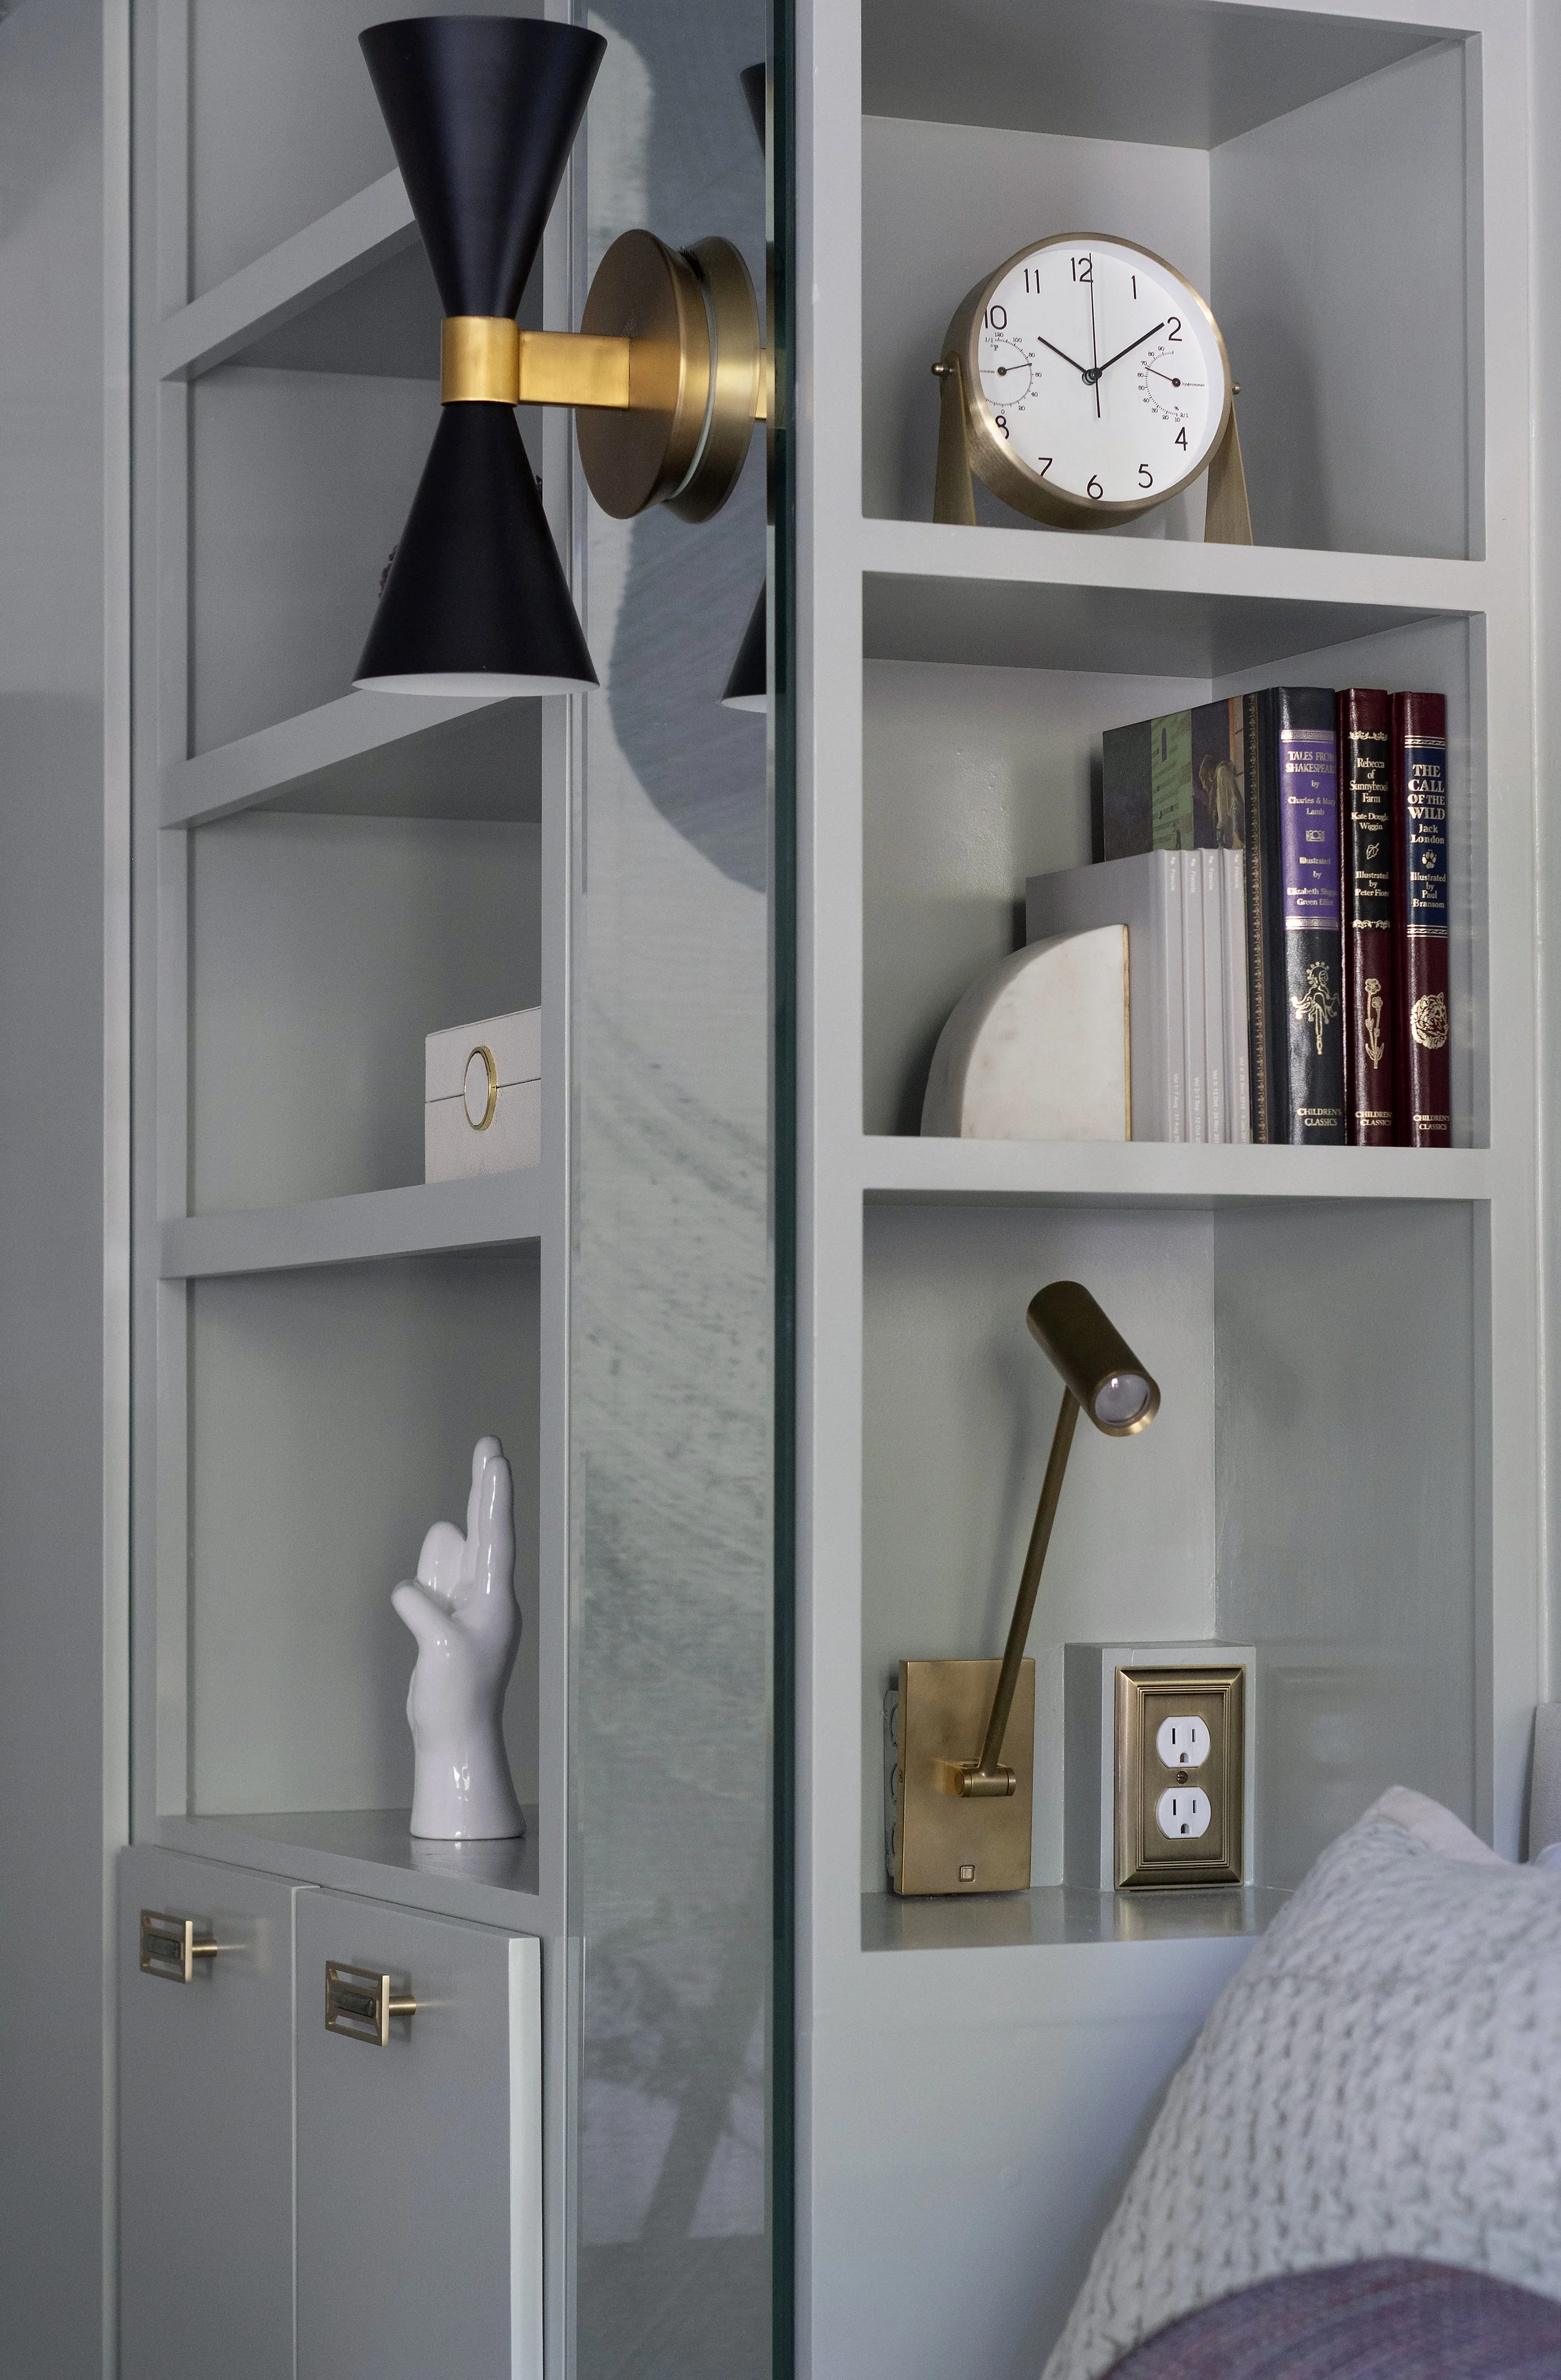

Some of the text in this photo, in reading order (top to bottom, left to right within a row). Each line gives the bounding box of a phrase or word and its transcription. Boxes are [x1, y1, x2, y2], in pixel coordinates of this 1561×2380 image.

[1070, 257, 1093, 283] 12
[1023, 268, 1041, 294] 11
[1131, 275, 1137, 300] 1
[984, 304, 1008, 330] 10
[1166, 316, 1183, 342] 2
[995, 415, 1010, 440] 8
[1174, 427, 1188, 452] 4
[1038, 457, 1053, 477] 7
[1138, 463, 1153, 489] 5
[1086, 475, 1104, 500] 6
[1287, 751, 1313, 761] TALES
[1285, 763, 1334, 774] SHAKESPEAR
[1356, 758, 1385, 769] Rebecca
[1367, 769, 1376, 779] of
[1412, 764, 1441, 778] THE
[1311, 779, 1320, 789] by
[1407, 779, 1445, 793] CALL
[1288, 796, 1314, 804] Charles
[1362, 793, 1381, 803] Farm
[1407, 794, 1445, 806] OF THE
[1306, 807, 1324, 816] Lamb
[1351, 812, 1367, 820] Kate
[1407, 806, 1445, 820] WILD
[1359, 822, 1383, 831] Wiggin
[1418, 824, 1439, 834] Jack
[1411, 834, 1445, 844] London
[1299, 856, 1331, 865] Illustrated
[1312, 871, 1322, 879] by
[1356, 871, 1389, 879] Illustrated
[1410, 871, 1446, 882] Illustrated
[1369, 879, 1378, 889] by
[1426, 881, 1435, 892] by
[1287, 887, 1319, 896] Elizabeth
[1354, 888, 1374, 896] Peter
[1422, 889, 1438, 899] Paul
[1412, 898, 1445, 908] Bransom
[1297, 1108, 1342, 1117] CHILDREN'S
[1304, 1118, 1337, 1127] CLASSICS
